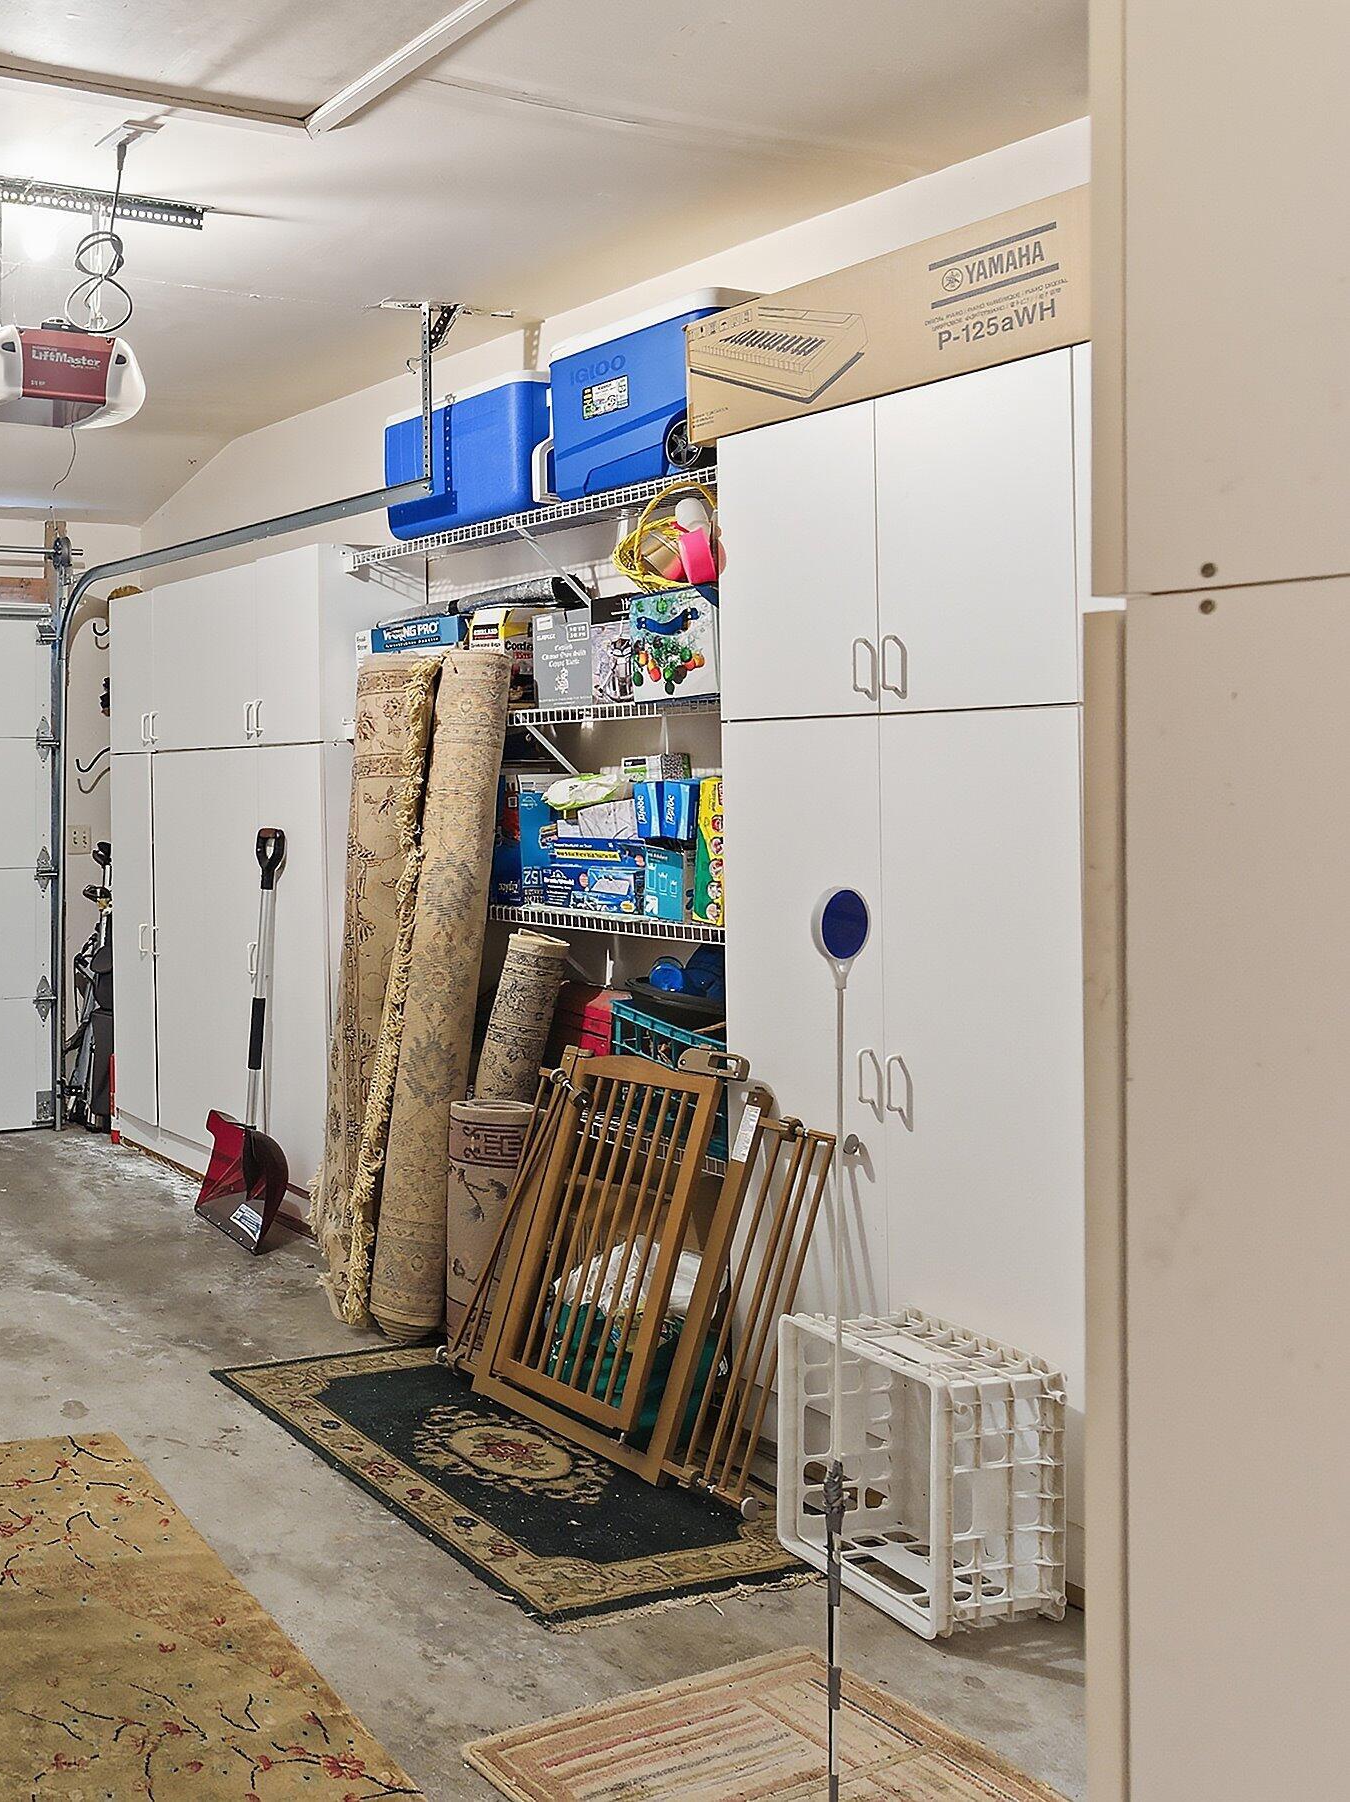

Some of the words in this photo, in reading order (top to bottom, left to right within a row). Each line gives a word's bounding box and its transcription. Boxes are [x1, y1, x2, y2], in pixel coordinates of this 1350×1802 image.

[965, 241, 1045, 284] YAMAHA
[938, 298, 1055, 351] P-125aWH
[31, 349, 101, 366] LiftMaster
[570, 354, 626, 386] IGLOO
